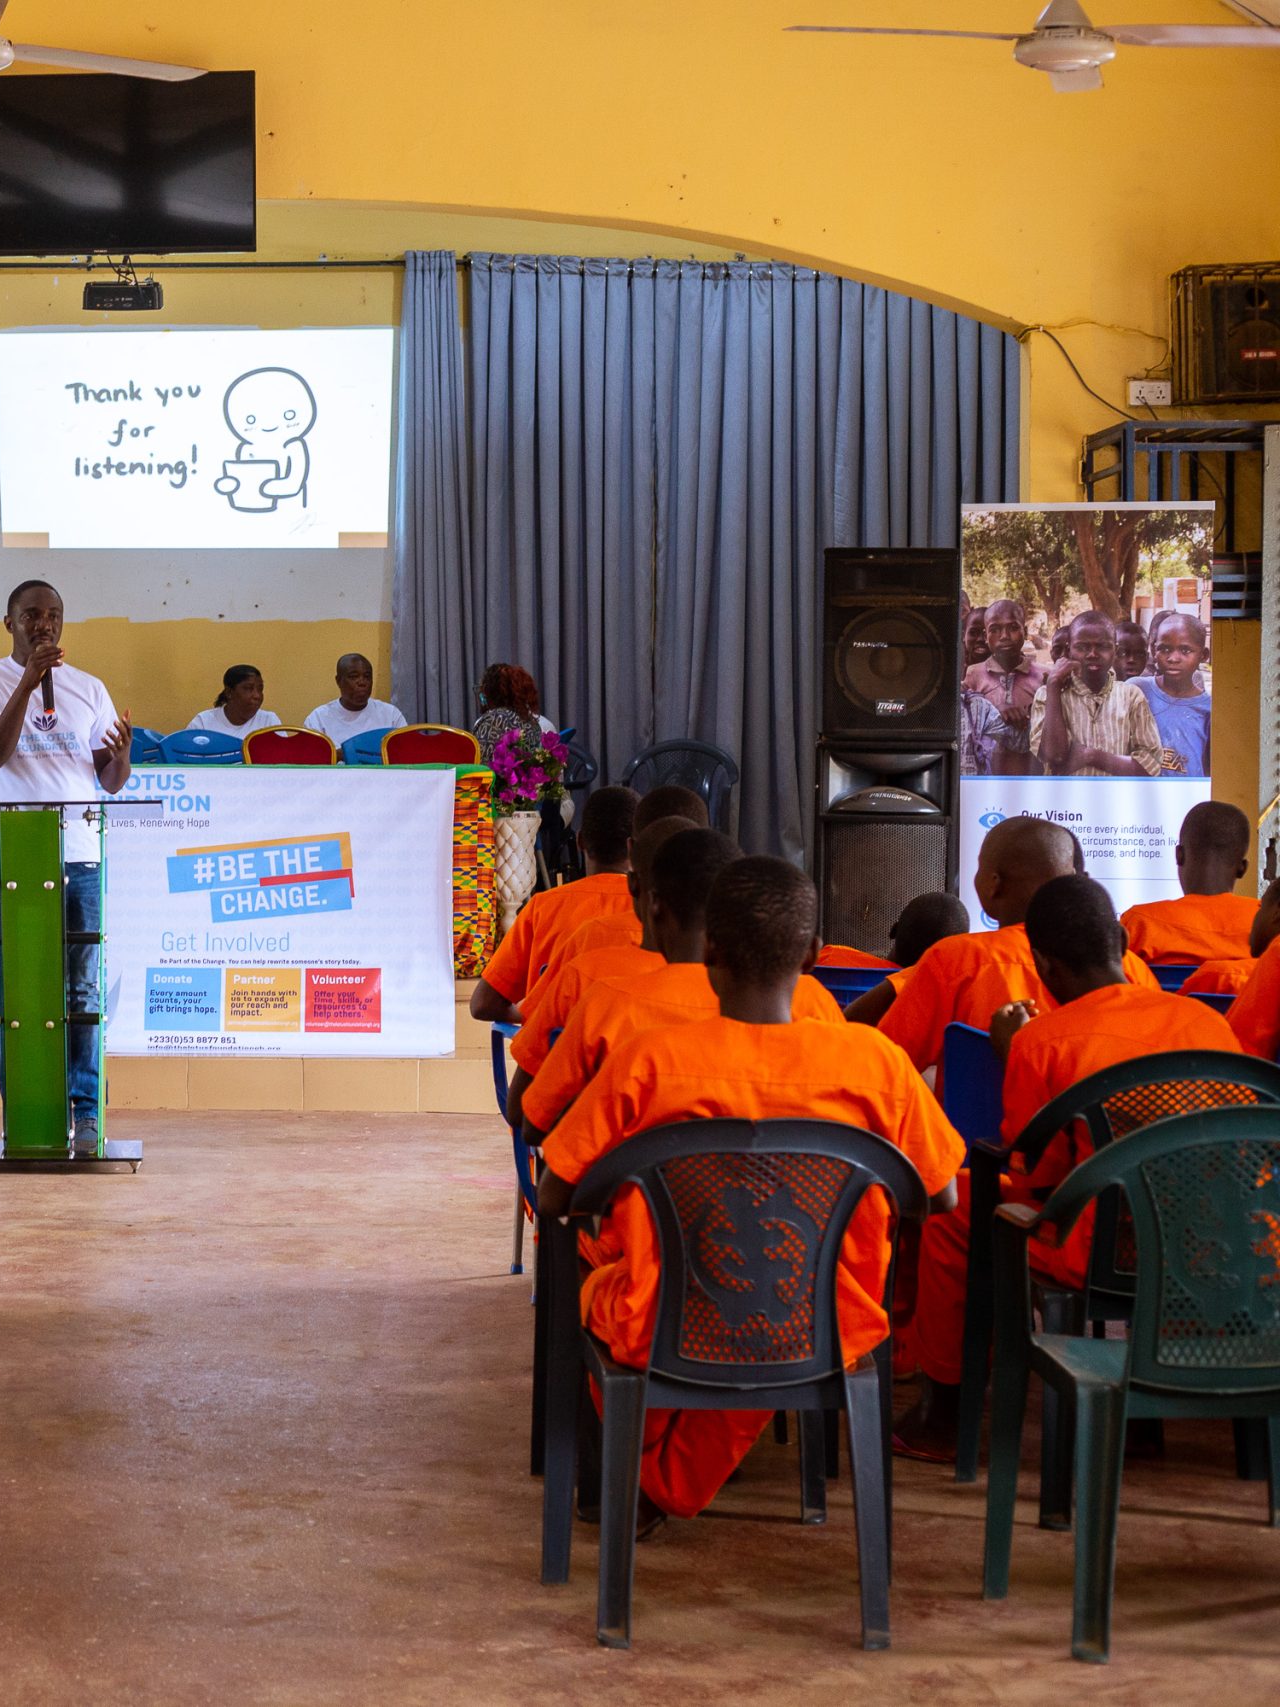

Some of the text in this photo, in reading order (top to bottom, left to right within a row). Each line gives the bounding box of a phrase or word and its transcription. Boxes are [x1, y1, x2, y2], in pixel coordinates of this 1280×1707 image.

[65, 380, 201, 407] Thank you
[107, 419, 155, 446] for
[74, 444, 198, 489] listening!
[124, 774, 186, 791] OTUS
[1045, 810, 1083, 821] Vision
[111, 818, 210, 829] Lives, Renewing Hope
[1094, 826, 1119, 836] every
[1120, 825, 1165, 836] individual,
[1082, 837, 1178, 847] circumstance, can liv
[1084, 849, 1163, 860] urpose, and hope.
[193, 846, 323, 884] #BE THE
[221, 885, 327, 915] CHANGE.
[161, 931, 290, 952] Get Involved
[153, 974, 193, 984] Donate
[233, 974, 276, 984] Partner
[312, 974, 366, 985] Volunteer
[149, 989, 173, 998] Every
[231, 989, 249, 997] Join
[149, 997, 202, 1005] counts, your
[149, 1005, 217, 1015] gift brings hope.
[230, 1009, 263, 1018] impact.
[313, 1010, 364, 1019] help others.
[148, 1035, 236, 1045] +233(0)53 8877 851
